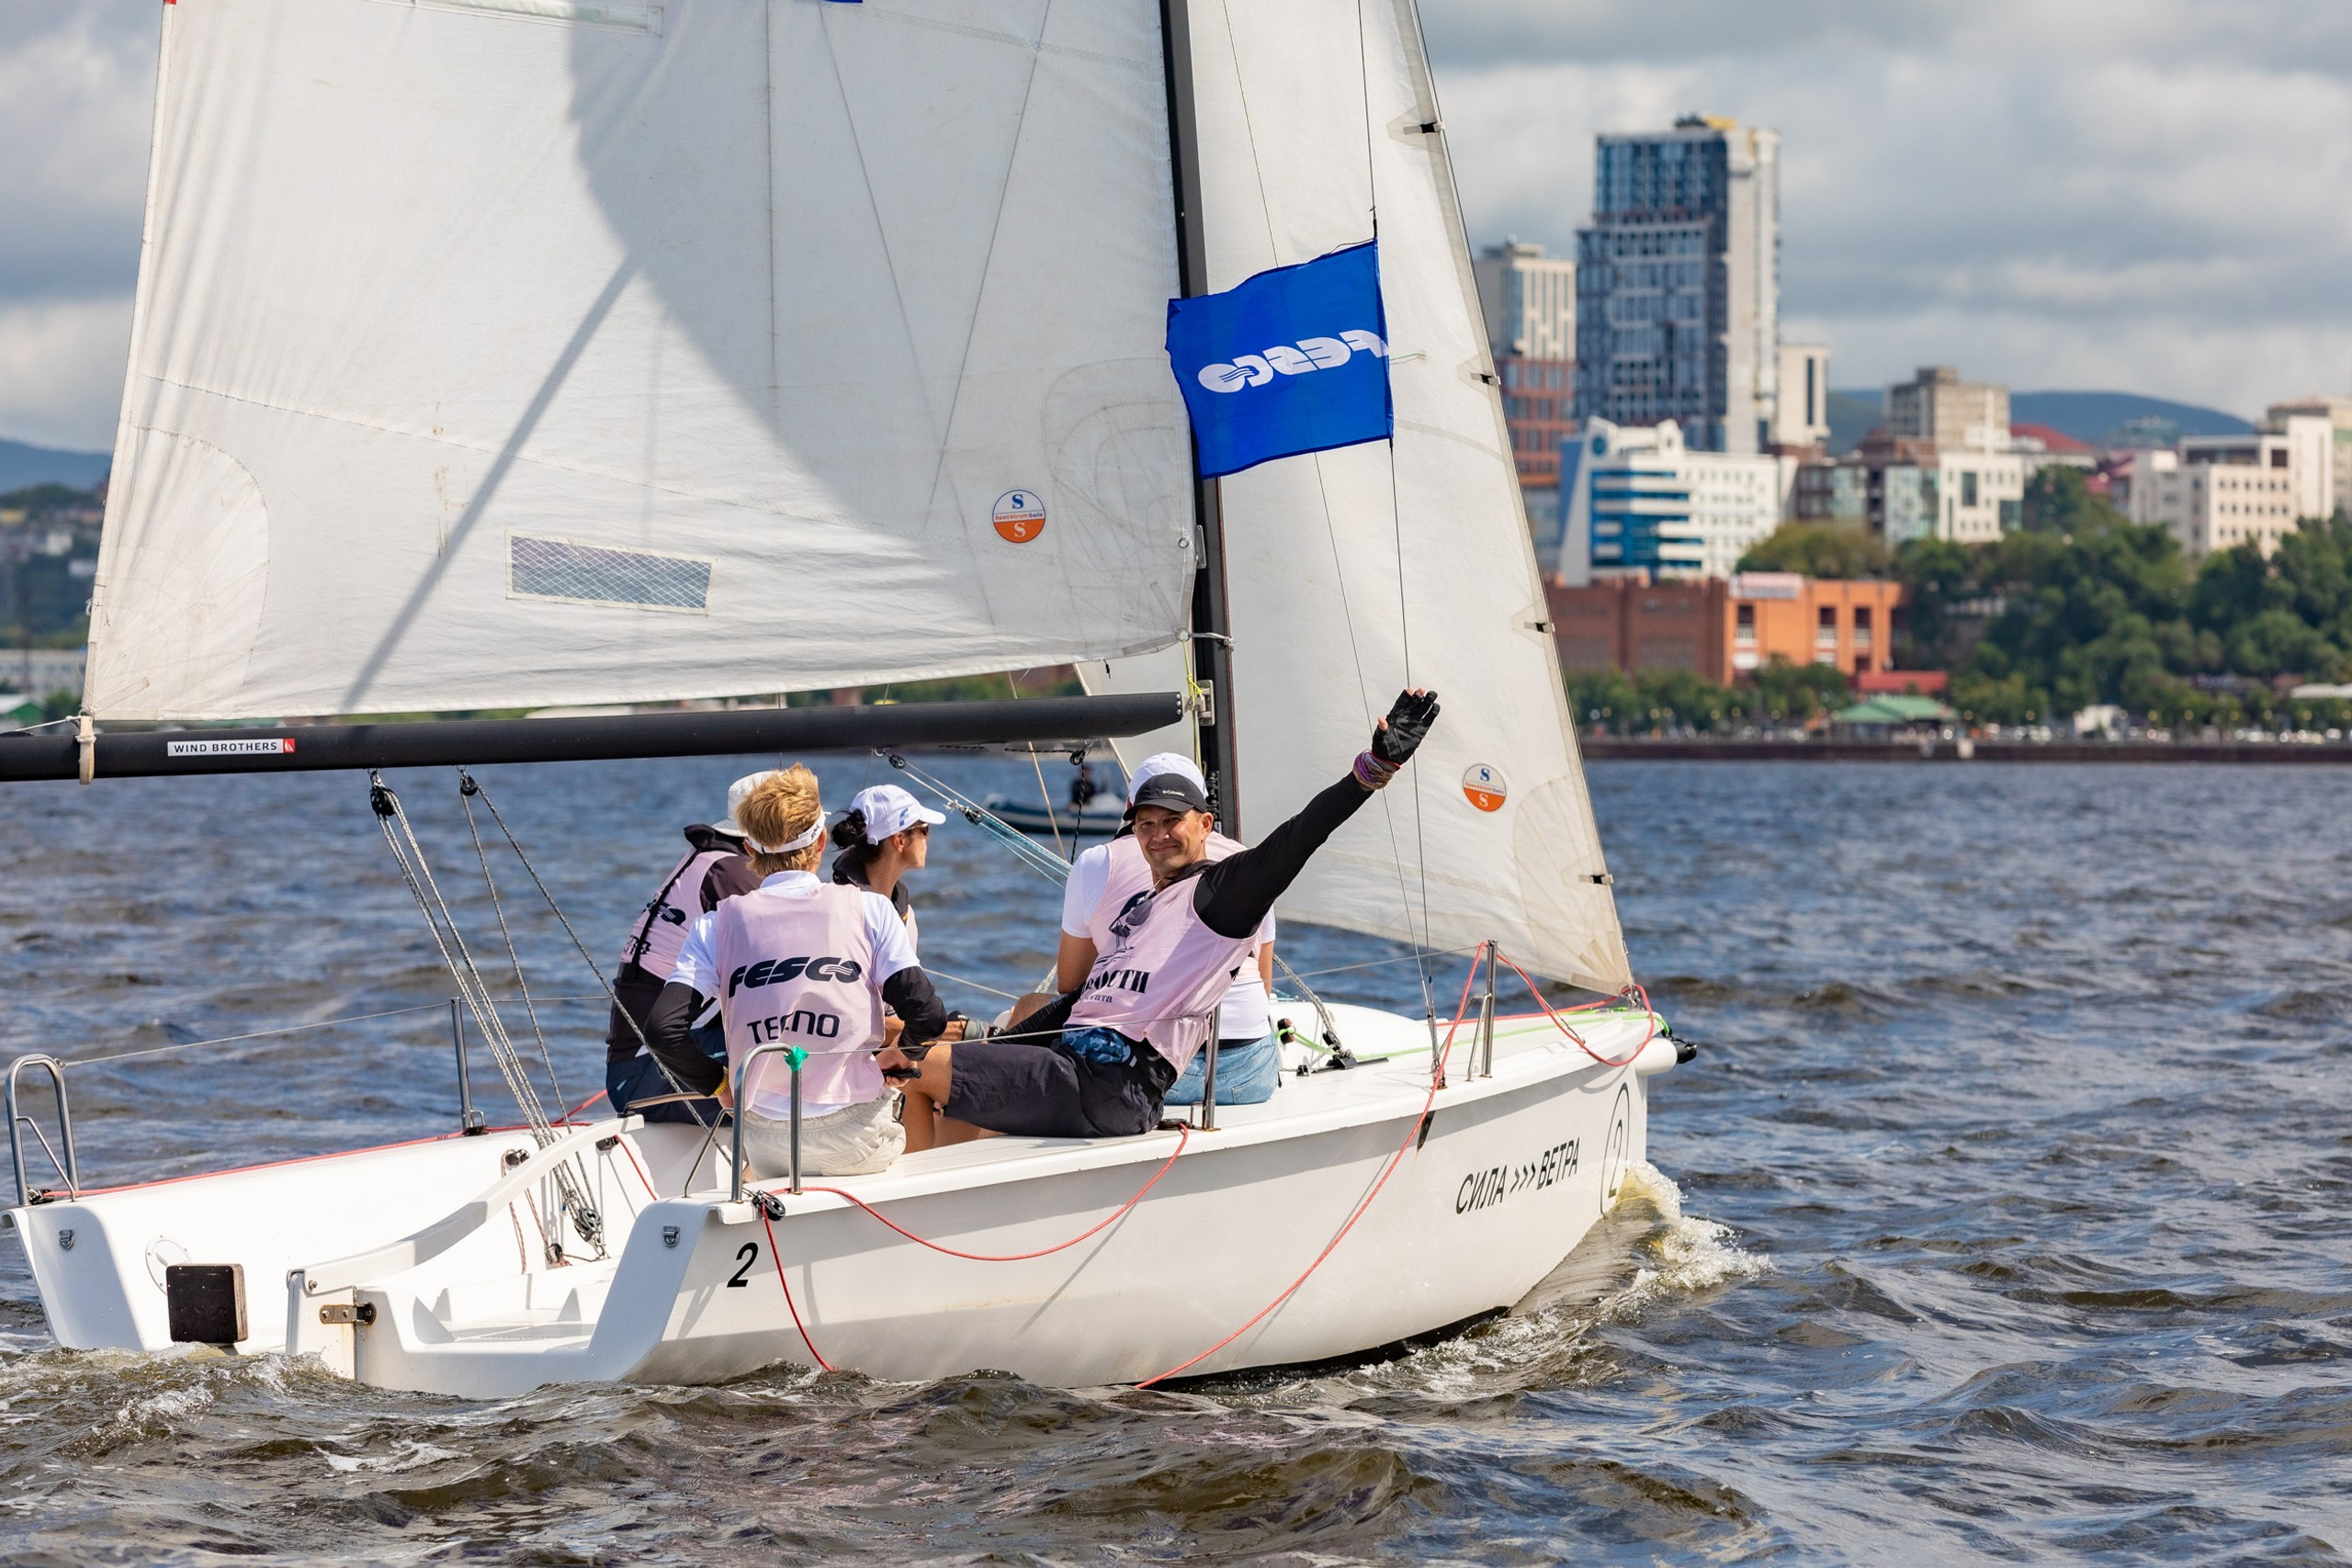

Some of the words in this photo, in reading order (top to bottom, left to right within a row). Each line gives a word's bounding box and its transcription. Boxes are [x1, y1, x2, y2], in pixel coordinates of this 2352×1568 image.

[1012, 494, 1023, 509] S
[1013, 522, 1026, 536] S
[174, 743, 208, 753] WIND
[211, 741, 277, 752] BROTHERS
[1480, 768, 1490, 781] S
[1478, 794, 1488, 807] S
[728, 956, 863, 998] FESCO
[1607, 1118, 1623, 1199] 2
[1455, 1164, 1508, 1215] СИЛА
[1536, 1136, 1581, 1191] ВЕТРА
[726, 1241, 759, 1288] 2
